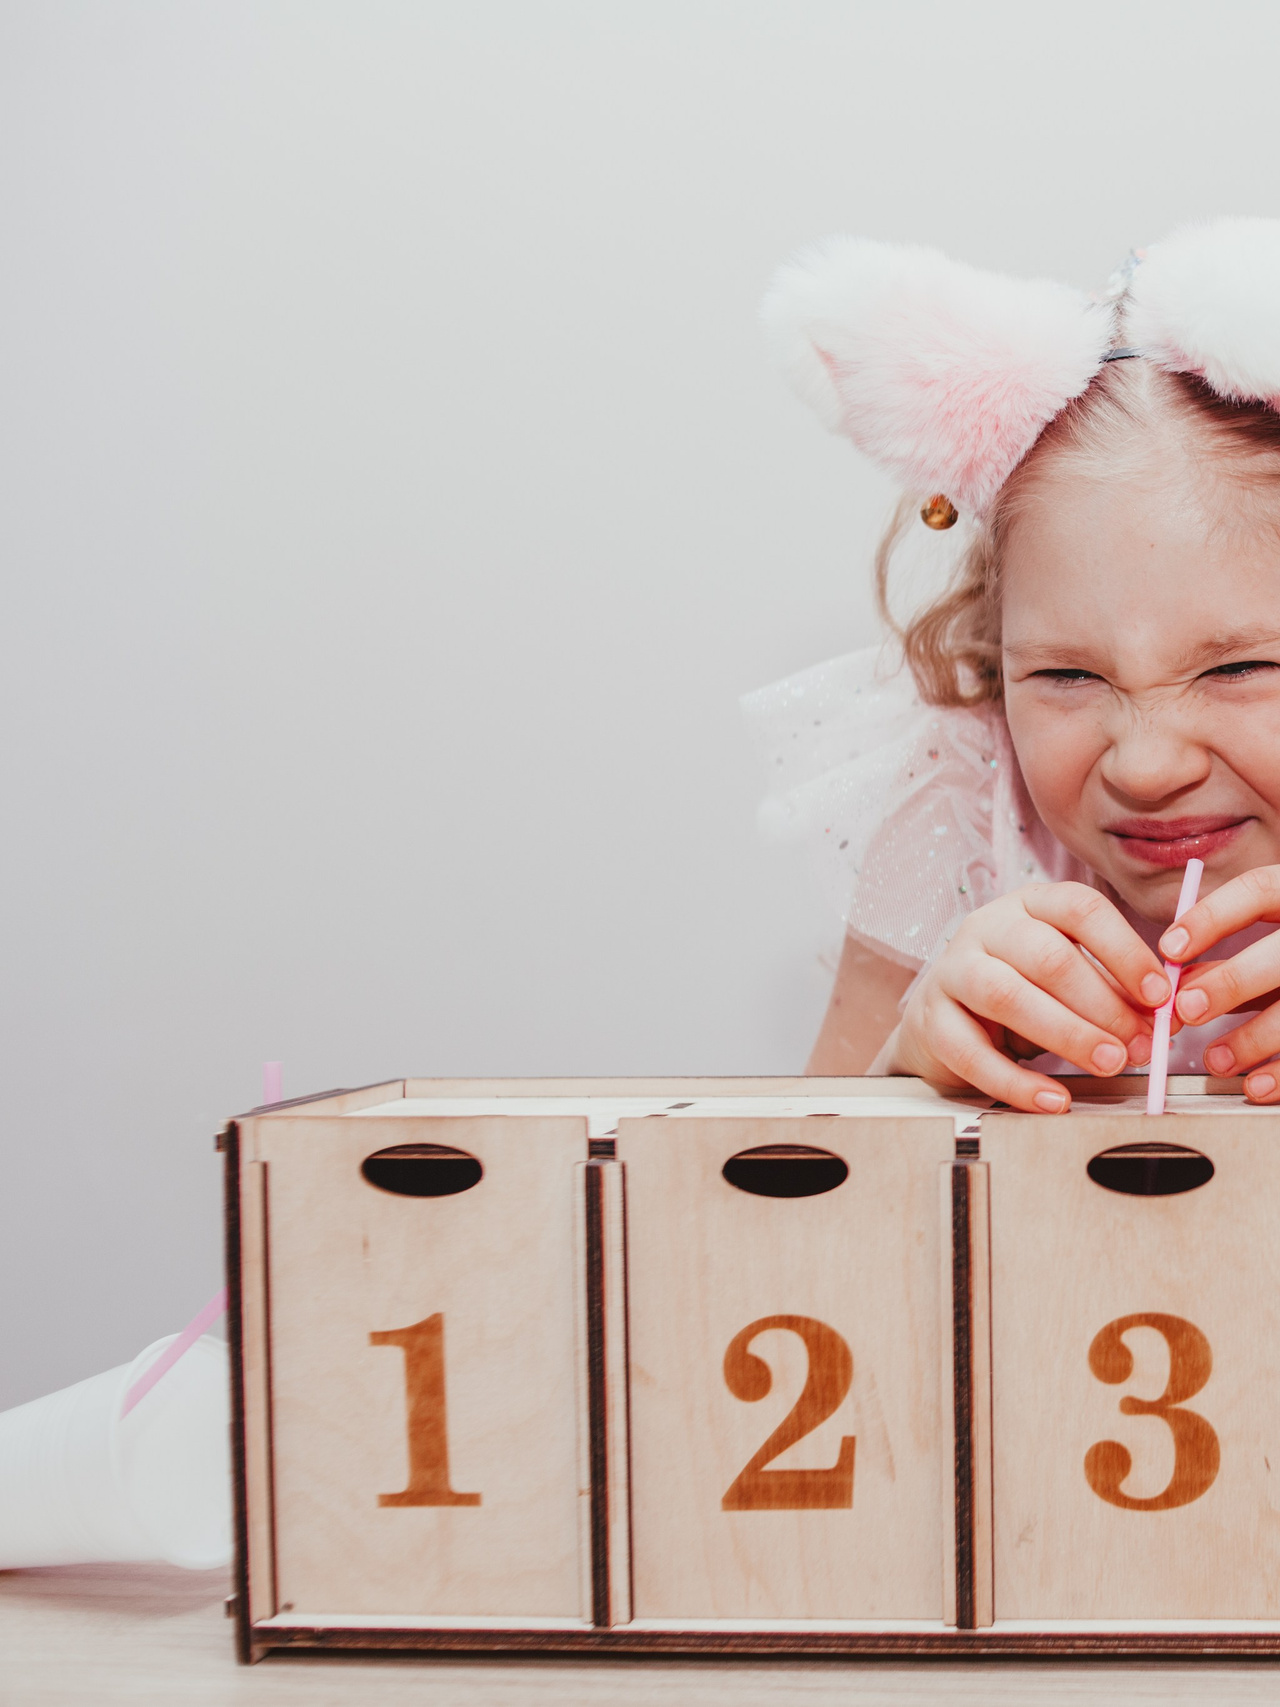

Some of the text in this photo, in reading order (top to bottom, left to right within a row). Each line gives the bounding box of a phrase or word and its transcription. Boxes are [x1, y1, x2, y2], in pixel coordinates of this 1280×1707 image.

[368, 1312, 482, 1508] 1
[720, 1313, 857, 1512] 2
[1083, 1311, 1222, 1512] 3
